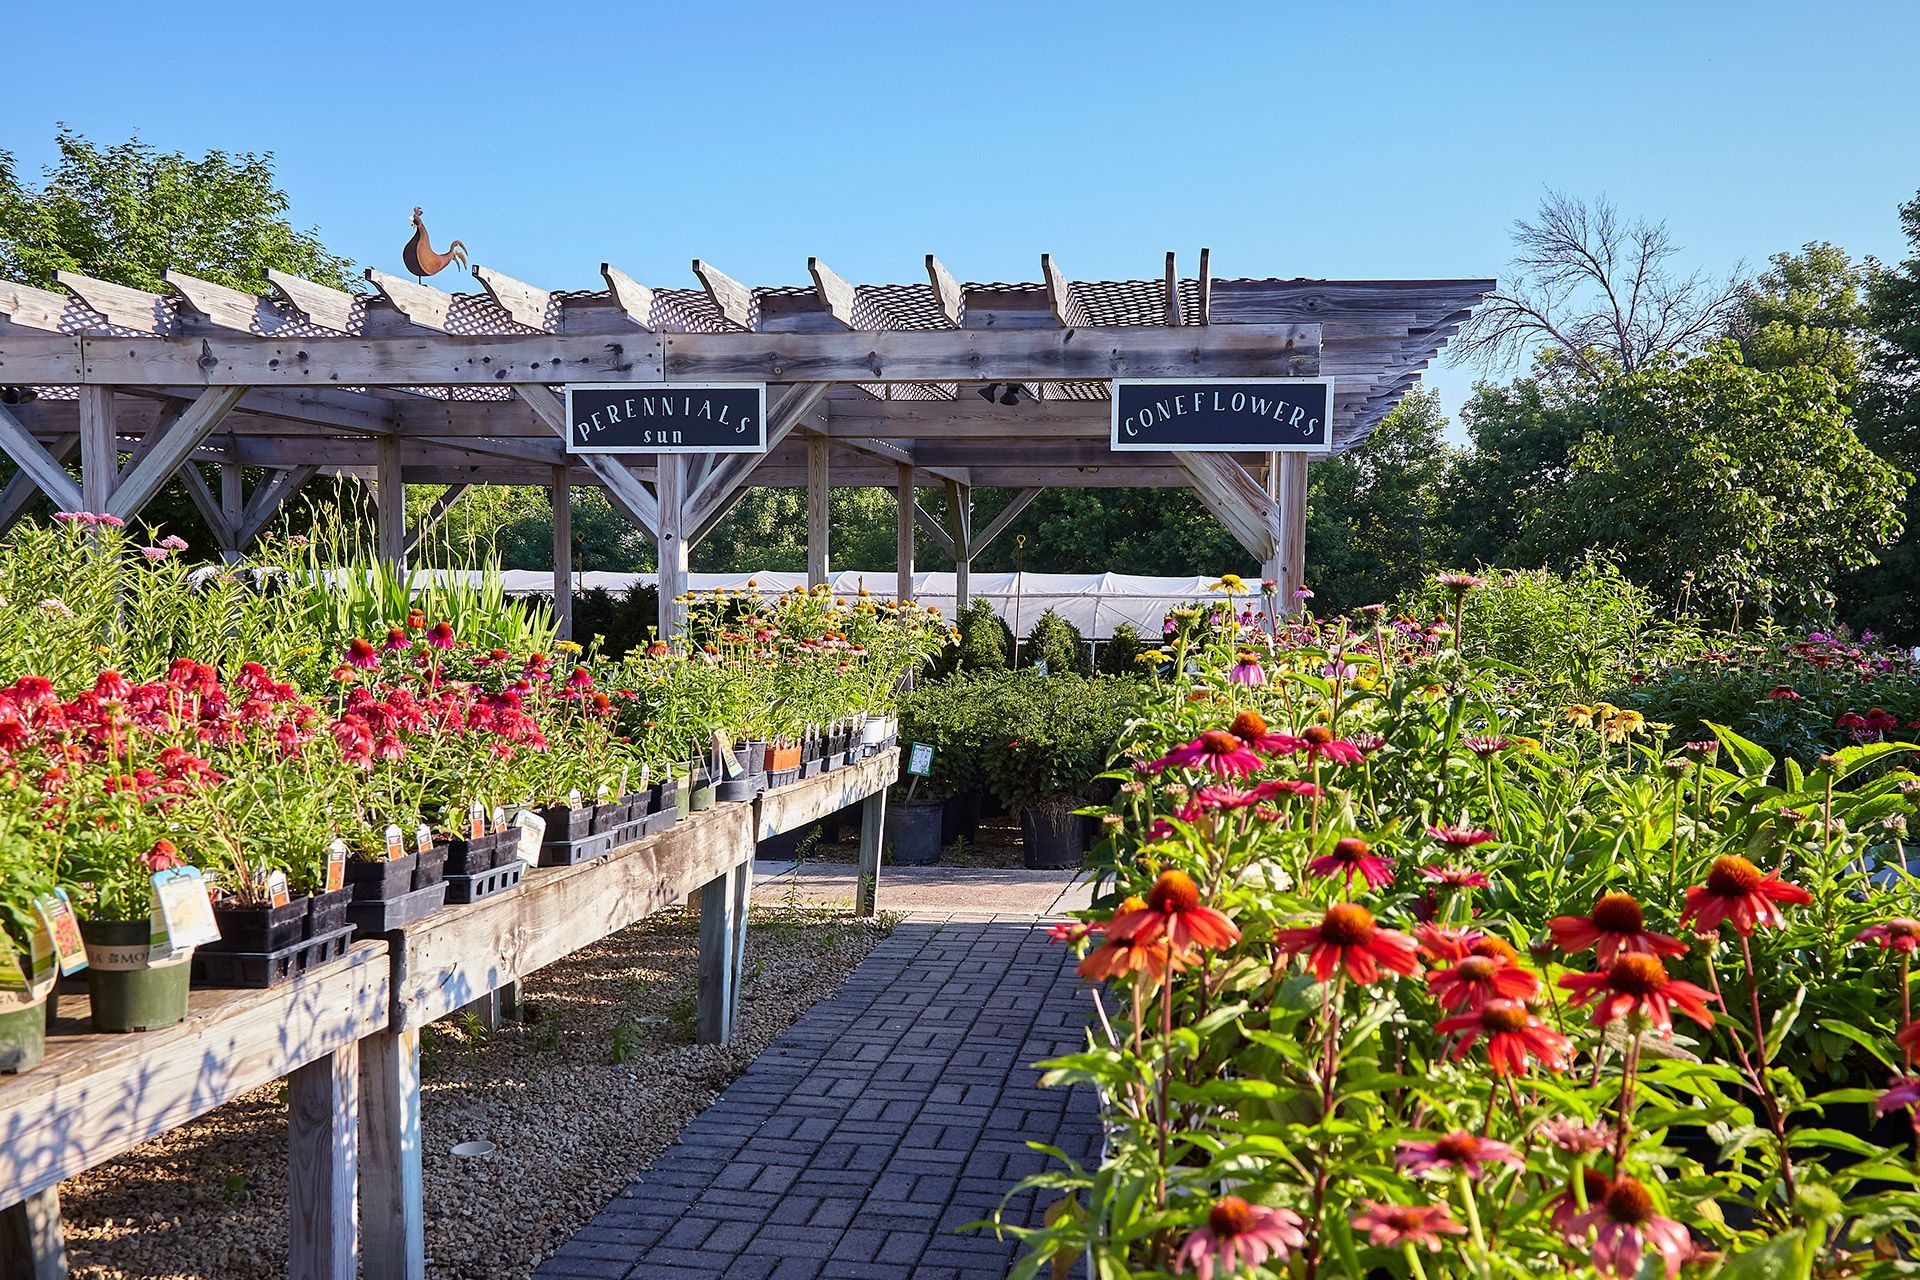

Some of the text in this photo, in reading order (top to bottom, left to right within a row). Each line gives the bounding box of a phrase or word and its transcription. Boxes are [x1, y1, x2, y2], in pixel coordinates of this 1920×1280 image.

[577, 396, 750, 442] PERENNIALS
[643, 429, 682, 444] sun
[1125, 391, 1319, 437] CONEFLOWERS
